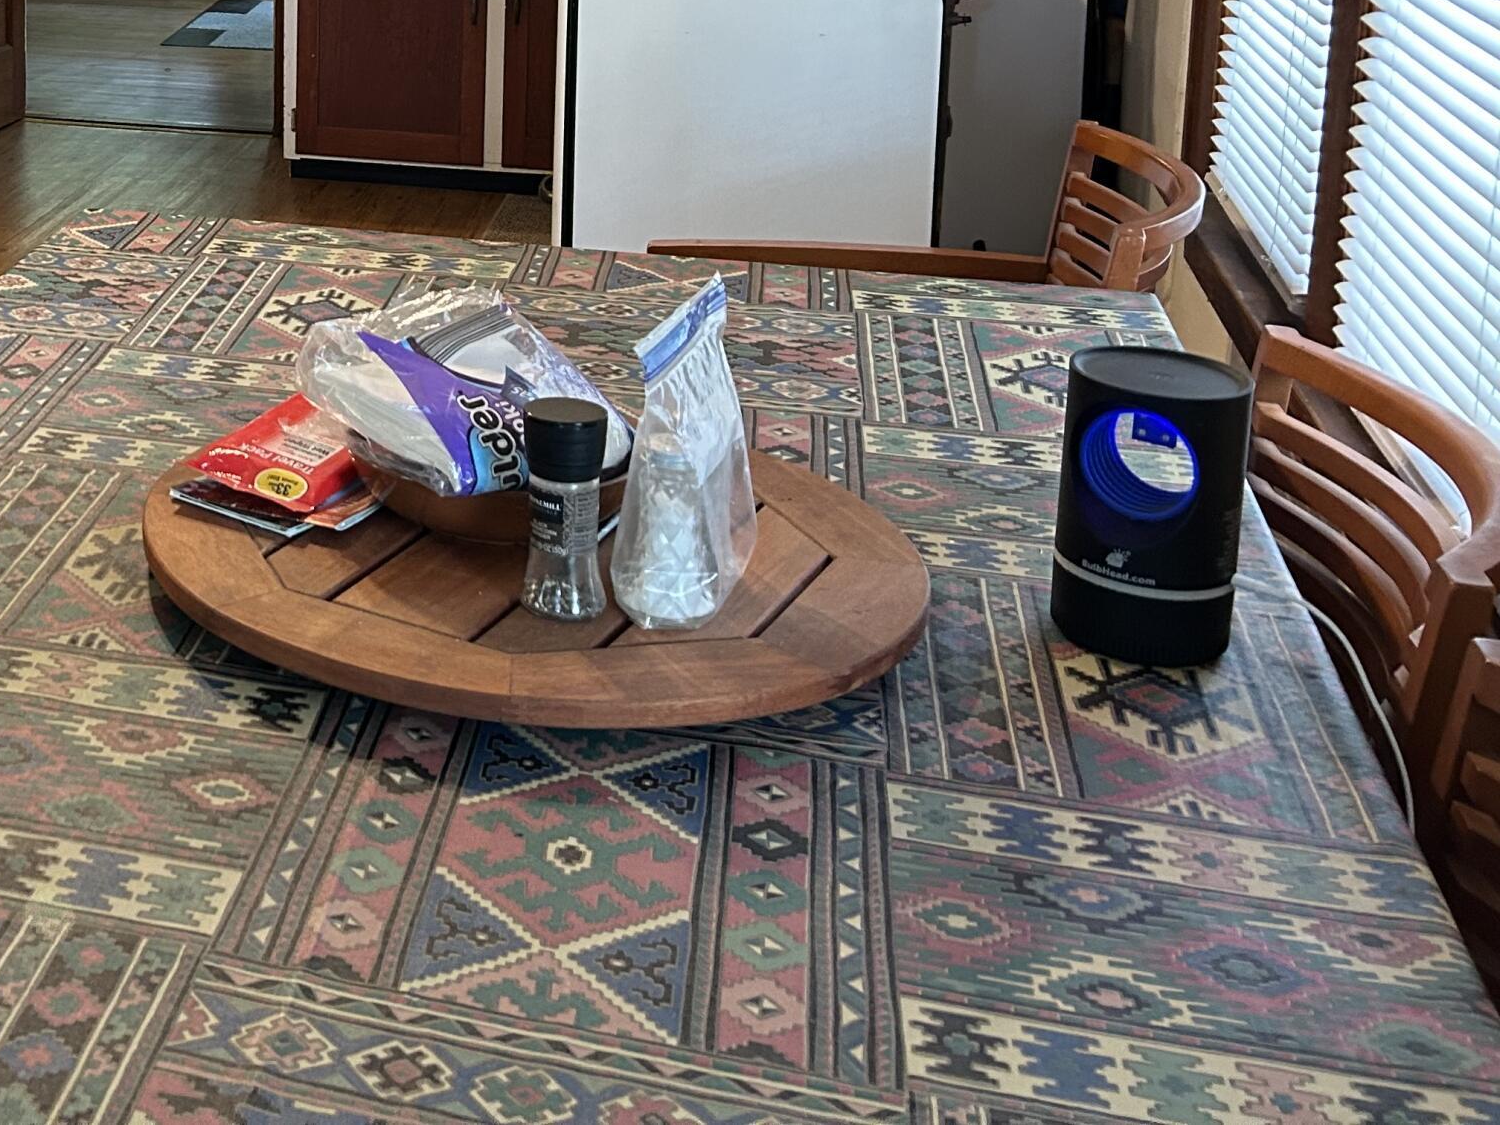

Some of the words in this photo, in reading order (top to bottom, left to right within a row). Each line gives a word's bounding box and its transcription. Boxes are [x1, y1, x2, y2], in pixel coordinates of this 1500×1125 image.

[239, 443, 272, 462] Pack
[456, 394, 523, 491] ulder
[272, 454, 315, 475] Travel
[1081, 557, 1156, 586] BulbHead.com
